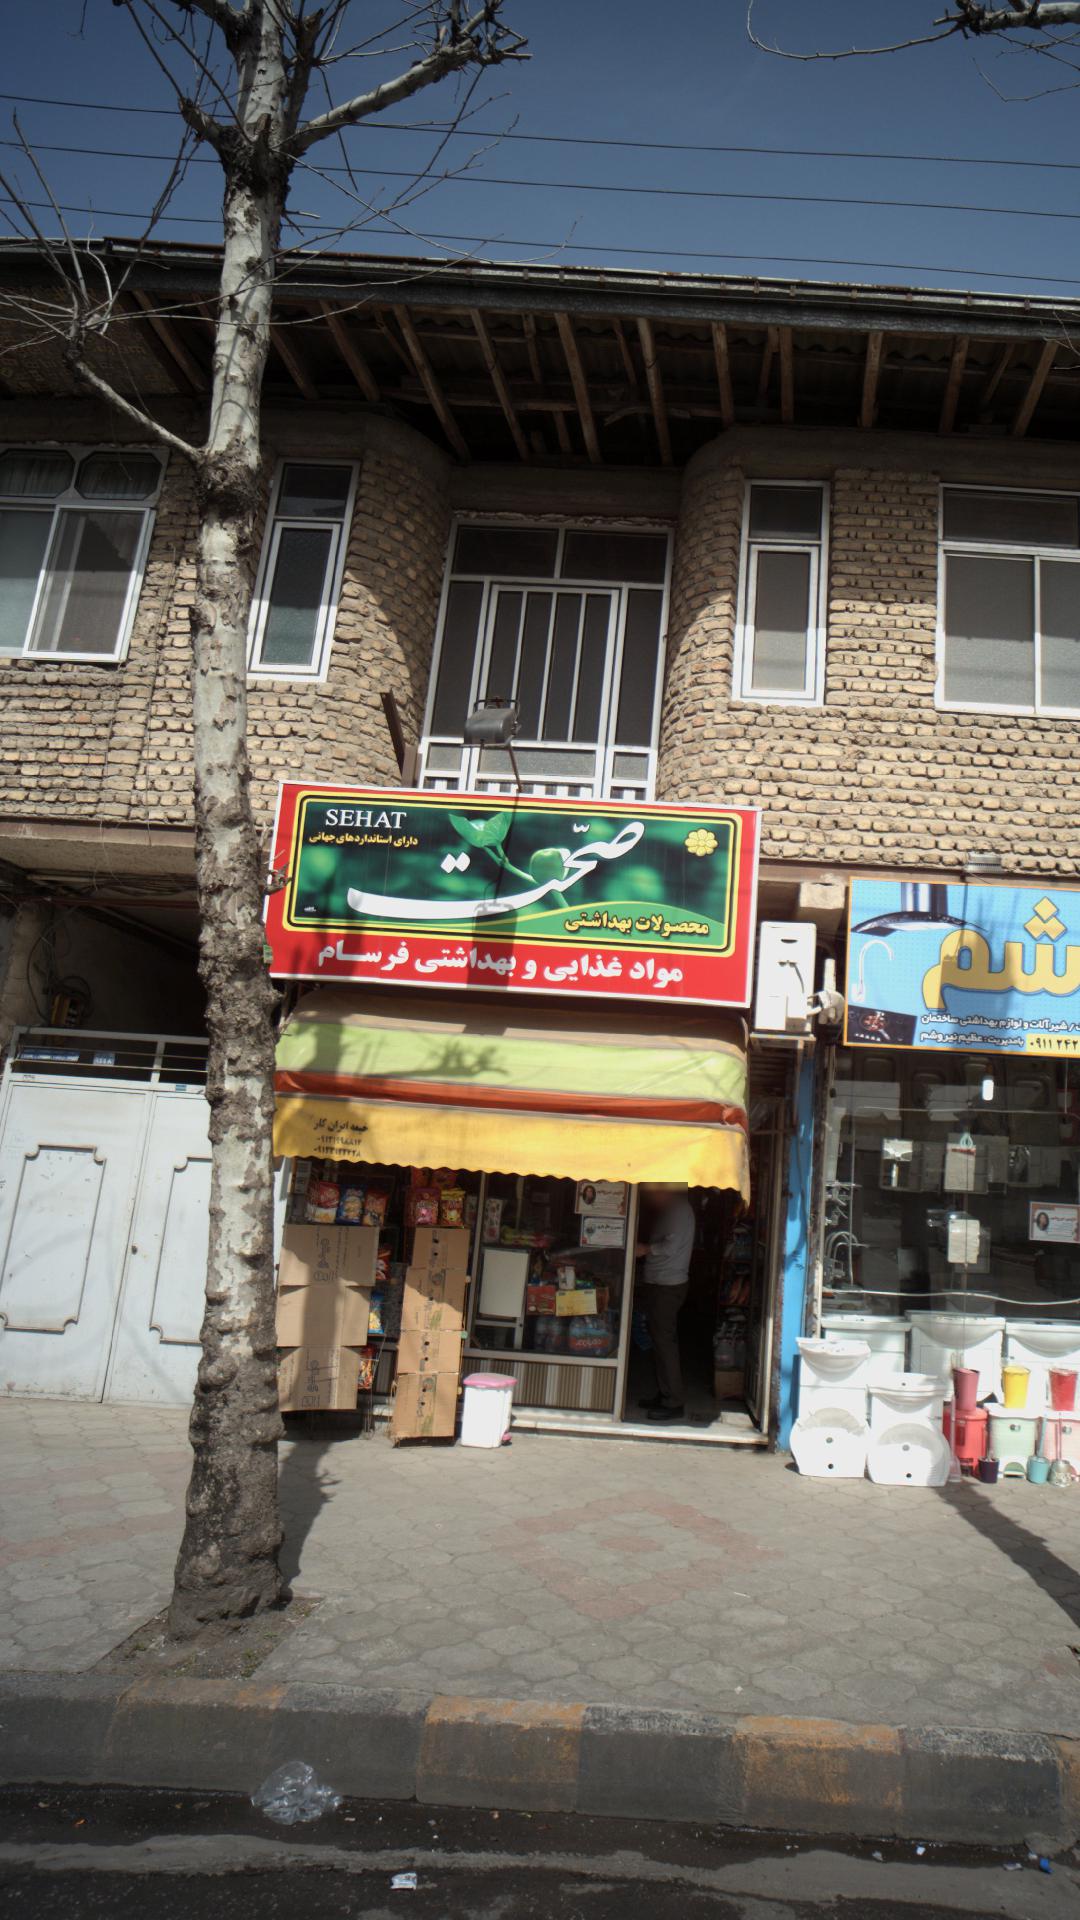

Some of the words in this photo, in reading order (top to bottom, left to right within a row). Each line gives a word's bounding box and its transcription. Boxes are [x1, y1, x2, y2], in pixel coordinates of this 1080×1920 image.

[325, 808, 407, 829] SEHAT
[393, 834, 419, 848] دارای
[564, 910, 633, 936] بهداشتی
[634, 912, 710, 937] محصولات
[318, 940, 410, 972] فرسام
[414, 948, 517, 978] بهداشتی
[522, 961, 538, 980] و
[543, 954, 623, 987] غذایی
[627, 958, 684, 988] مواد
[921, 1014, 958, 1024] ساختمان
[960, 1016, 998, 1027] بهداشتی
[1030, 1037, 1052, 1049] ۰۹۱۱
